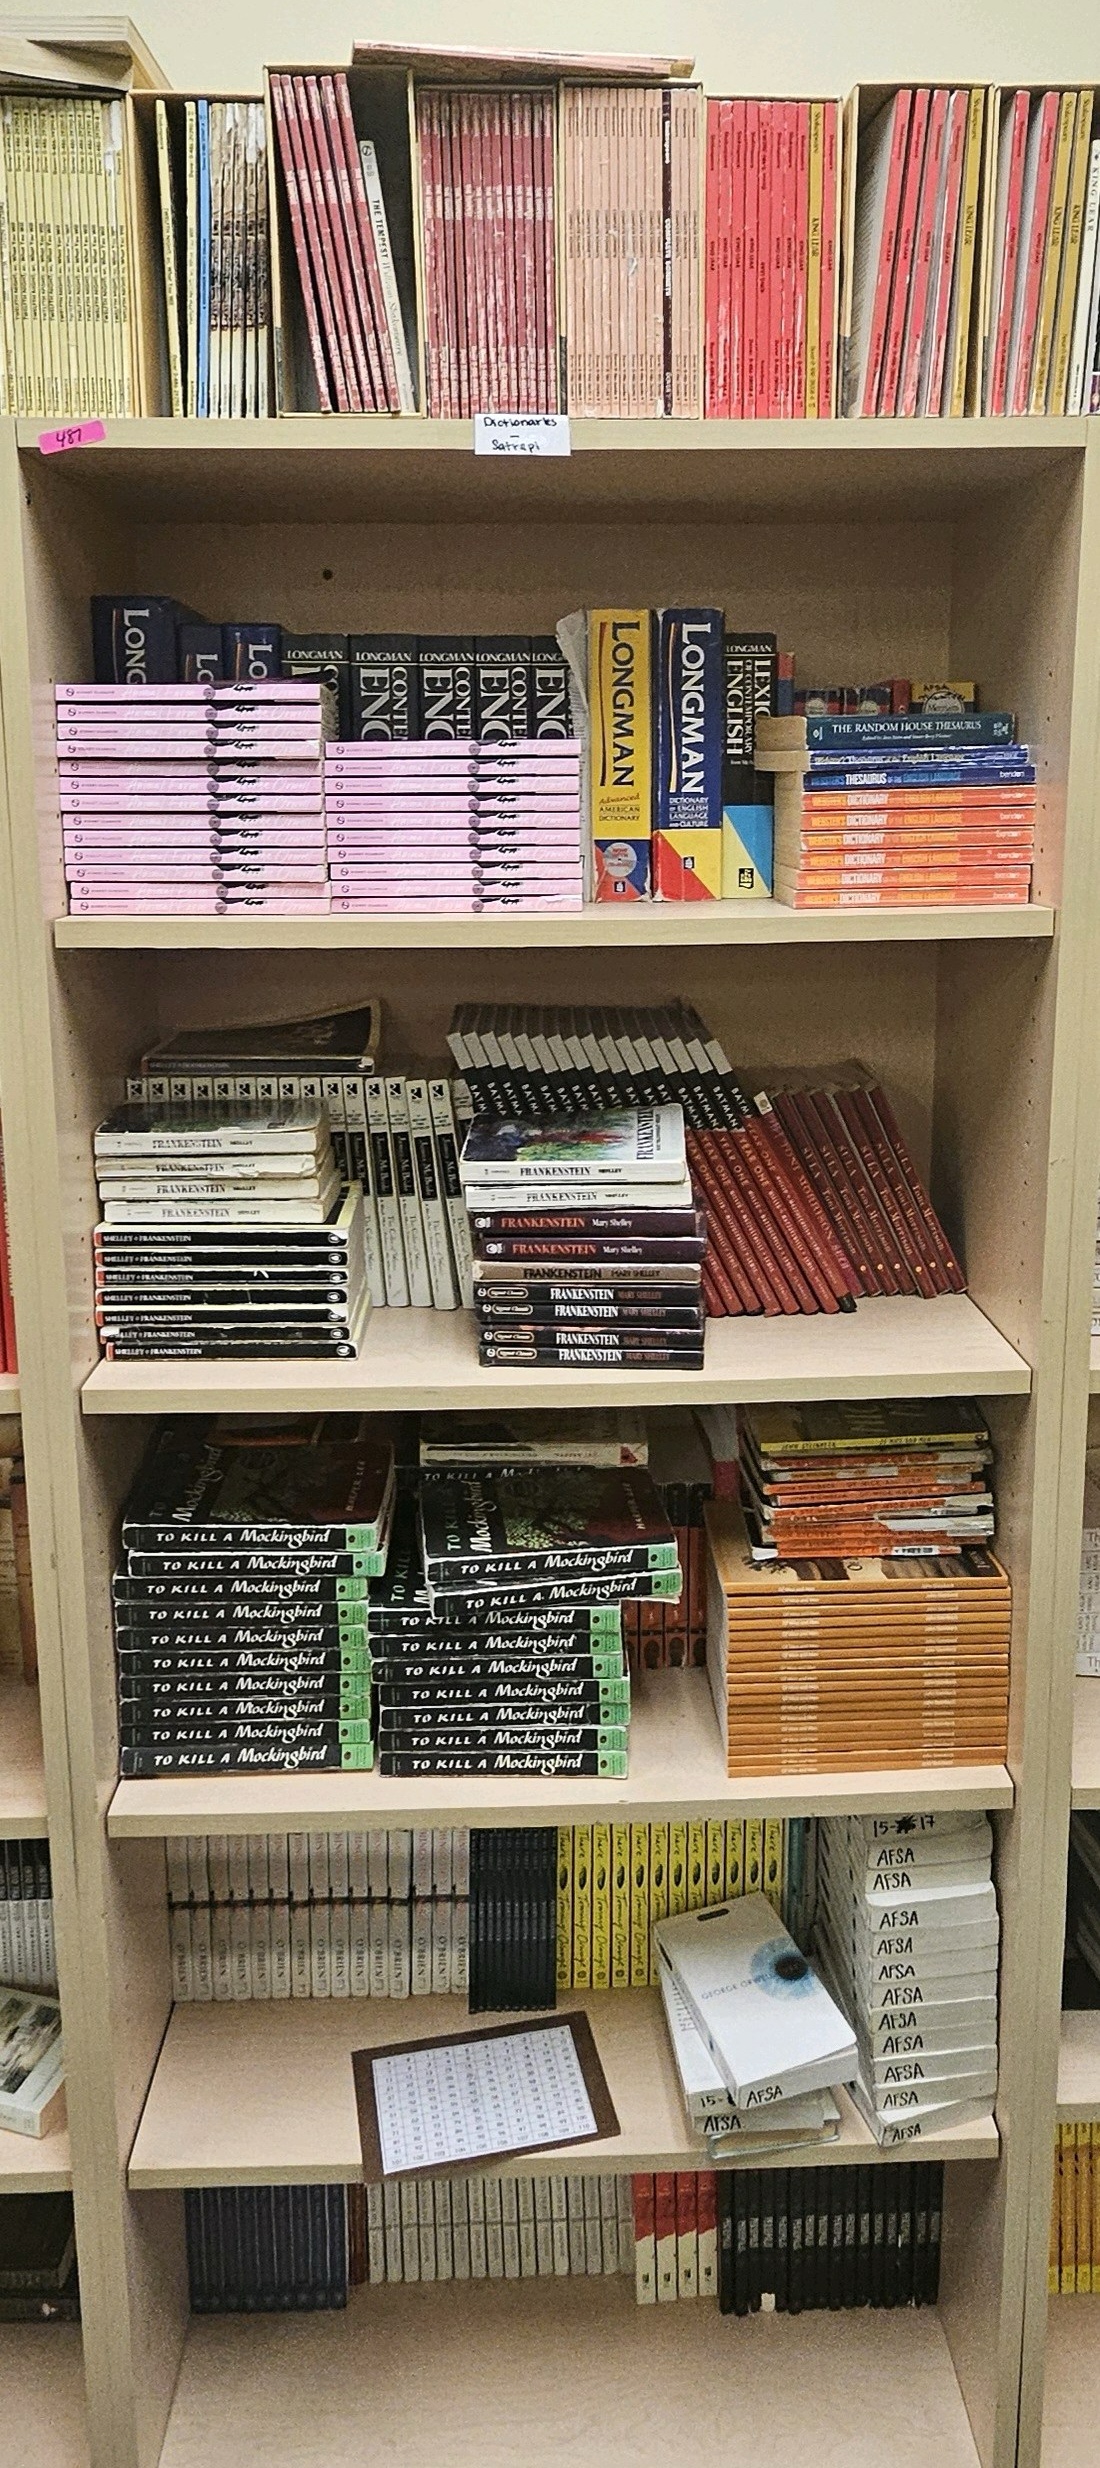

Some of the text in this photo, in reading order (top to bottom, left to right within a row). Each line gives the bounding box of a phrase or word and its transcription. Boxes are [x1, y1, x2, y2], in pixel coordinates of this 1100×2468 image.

[373, 200, 383, 218] THE
[1087, 167, 1100, 232] KING LEAR
[376, 219, 389, 258] TEMPEST
[56, 428, 81, 447] 487
[123, 608, 150, 684] LONG
[287, 650, 343, 660] LONGMAN
[726, 644, 772, 653] LONGMAN
[356, 652, 412, 661] LONGMAN
[419, 652, 475, 662] LONGMAN
[476, 652, 531, 662] LONGMAN
[532, 653, 563, 662] LONG
[754, 660, 771, 717] LEXIC
[612, 621, 640, 787] LONGMAN
[681, 622, 711, 794] LONGMAN
[726, 660, 744, 755] ENGLISH
[832, 720, 982, 733] THE RANDOM HOUSE THESAURUS
[846, 773, 887, 785] THESAURUS
[599, 793, 640, 804] Advanced
[677, 1087, 703, 1129] BATMAN
[693, 1085, 719, 1127] BATMAN
[713, 1085, 738, 1127] BATMAN
[152, 1138, 223, 1149] FRANKENSTEIN
[519, 1166, 592, 1176] FRANKENSTEIN
[156, 1184, 226, 1194] FRANKENSTEIN
[526, 1192, 598, 1202] FRANKENSTEIN
[162, 1208, 230, 1218] FRANKENSTEIN
[501, 1217, 633, 1229] FRANKENSTEIN Mary Shelley
[512, 1243, 643, 1255] FRANKENSTEIN Mary Shelley
[523, 1268, 602, 1278] FRANKENSTEIN
[550, 1288, 614, 1300] FRANKENSTEIN
[554, 1305, 619, 1317] FRANKENSTEIN
[556, 1333, 620, 1345] FRANKENSTEIN
[558, 1349, 622, 1361] FRANKENSTEIN
[156, 1529, 331, 1549] TO KILL A Mockingbird
[163, 1555, 338, 1576] TO KILL A Mockingbird
[461, 1549, 634, 1574] TO KILL A Mockingbird
[466, 1578, 638, 1609] TO KILL A Mockingbird
[151, 1628, 324, 1649] TO KILL A Mockingbird
[405, 1658, 578, 1679] TO KILL A Mockingbird
[152, 1675, 325, 1696] TO KILL A Mockingbird
[411, 1681, 584, 1702] TO KILL A Mockingbird
[154, 1744, 328, 1768] TO KILL A Mockingbird
[412, 1753, 583, 1775] TO KILL A Mockingbird
[877, 1848, 915, 1867] AFSA
[873, 1872, 912, 1890] AFSA
[879, 1910, 919, 1930] AFSA
[877, 1937, 913, 1955] AFSA
[878, 1964, 915, 1980] AFSA
[702, 1985, 738, 2000] GEORGE
[881, 1986, 923, 2007] AFSA
[878, 2011, 917, 2030] AFSA
[882, 2035, 924, 2053] AFSA
[884, 2062, 925, 2083] AFSA
[746, 2085, 783, 2108] AFSA
[883, 2091, 918, 2109] AFSA
[703, 2114, 742, 2133] AFSA
[892, 2123, 922, 2143] AFSA
